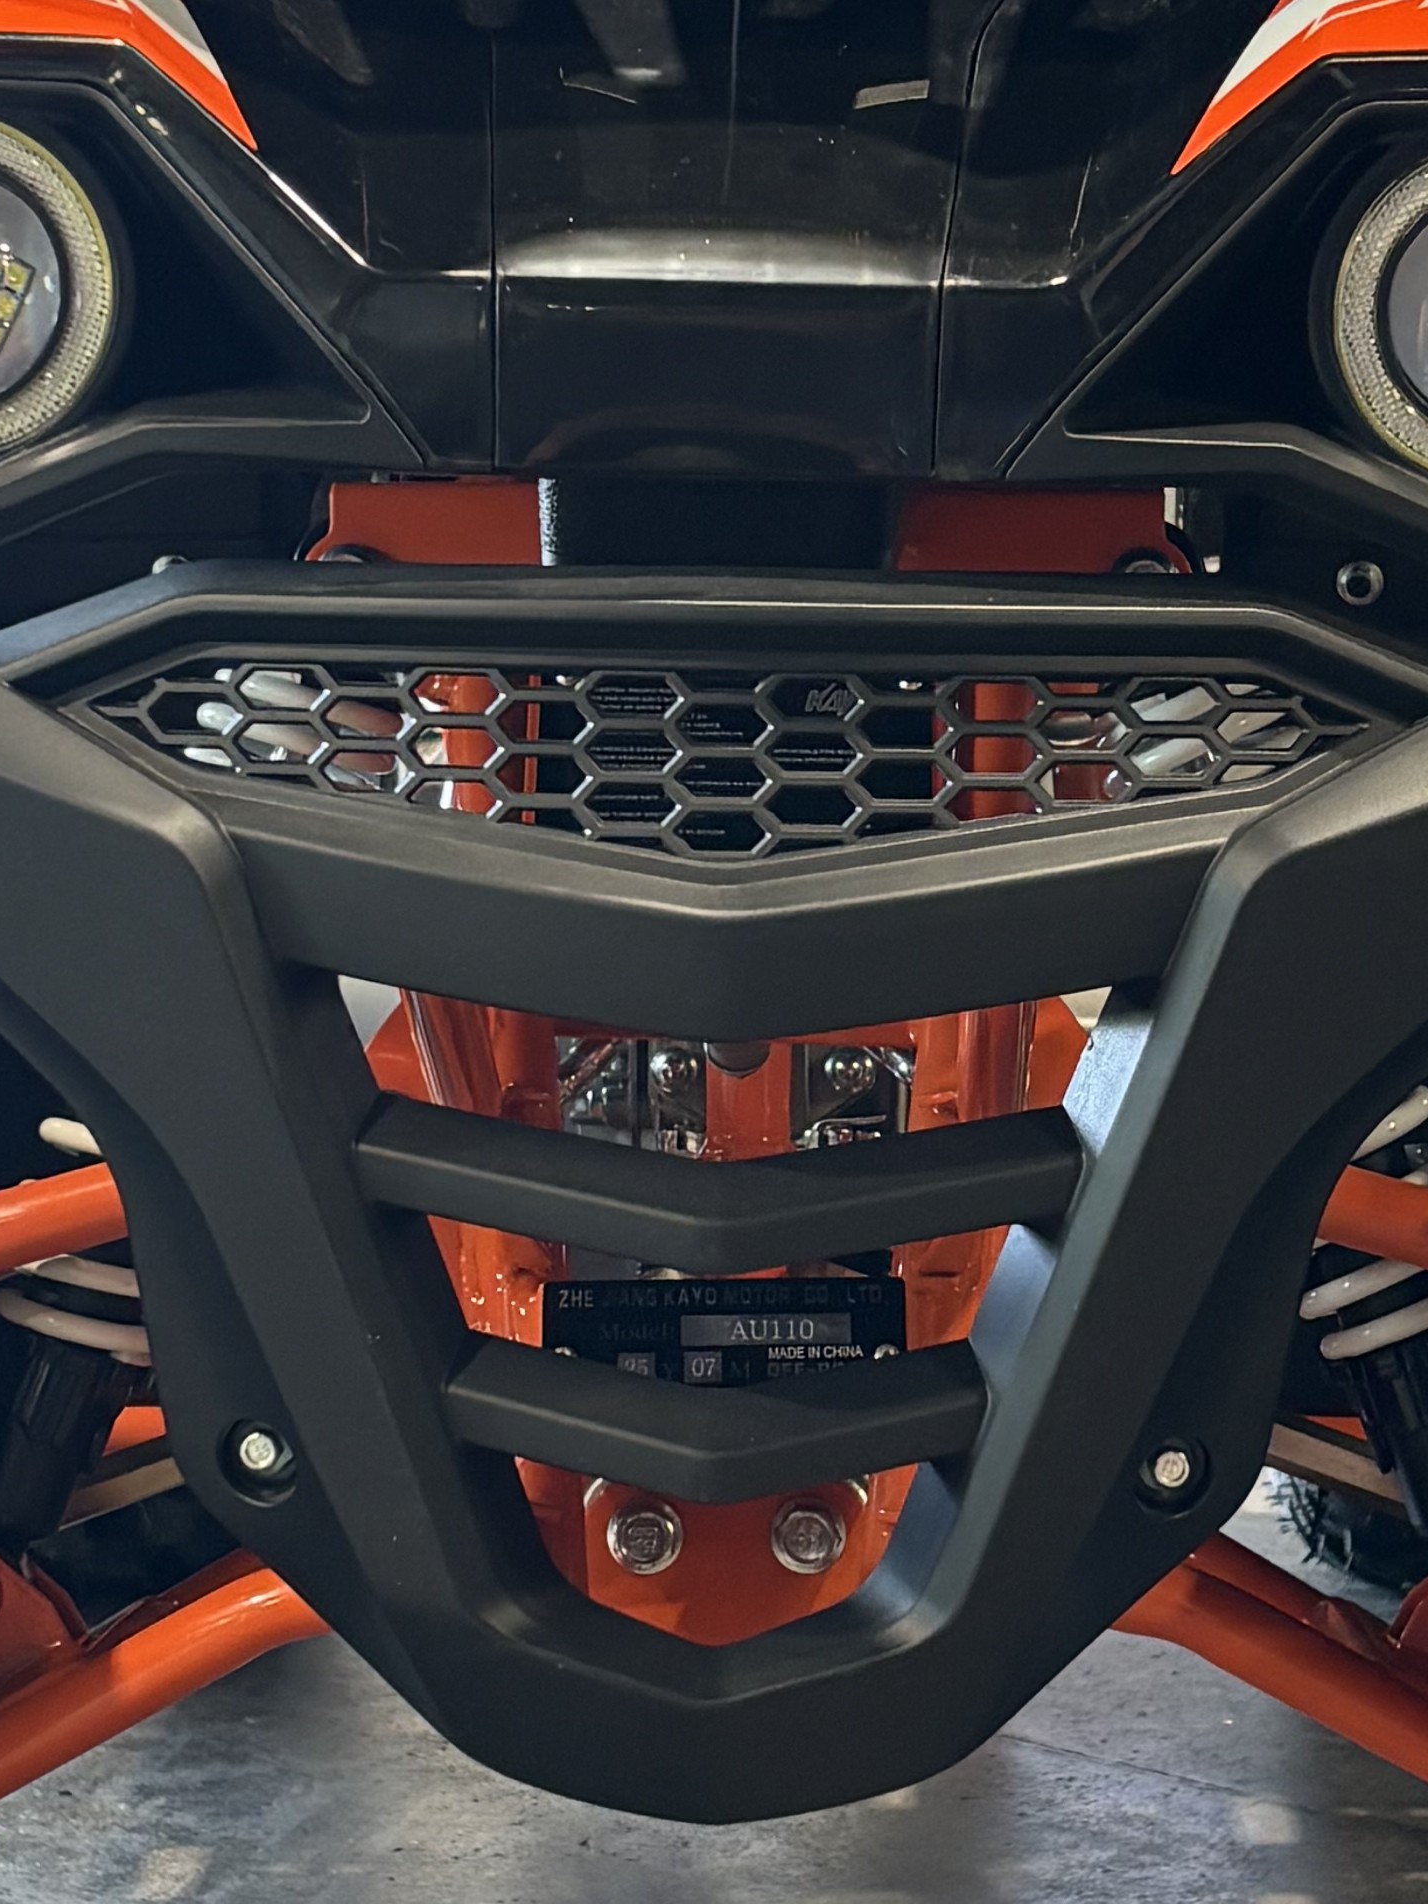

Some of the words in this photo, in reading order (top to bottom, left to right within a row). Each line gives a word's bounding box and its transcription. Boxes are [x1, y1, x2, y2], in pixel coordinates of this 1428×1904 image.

[558, 1289, 595, 1308] ZHE
[663, 1287, 717, 1306] KAYO
[723, 1286, 791, 1306] MOTOR
[729, 1318, 815, 1341] AU110
[768, 1347, 806, 1360] MADE
[807, 1346, 821, 1359] IN
[823, 1344, 864, 1358] CHINA
[690, 1357, 716, 1377] 07
